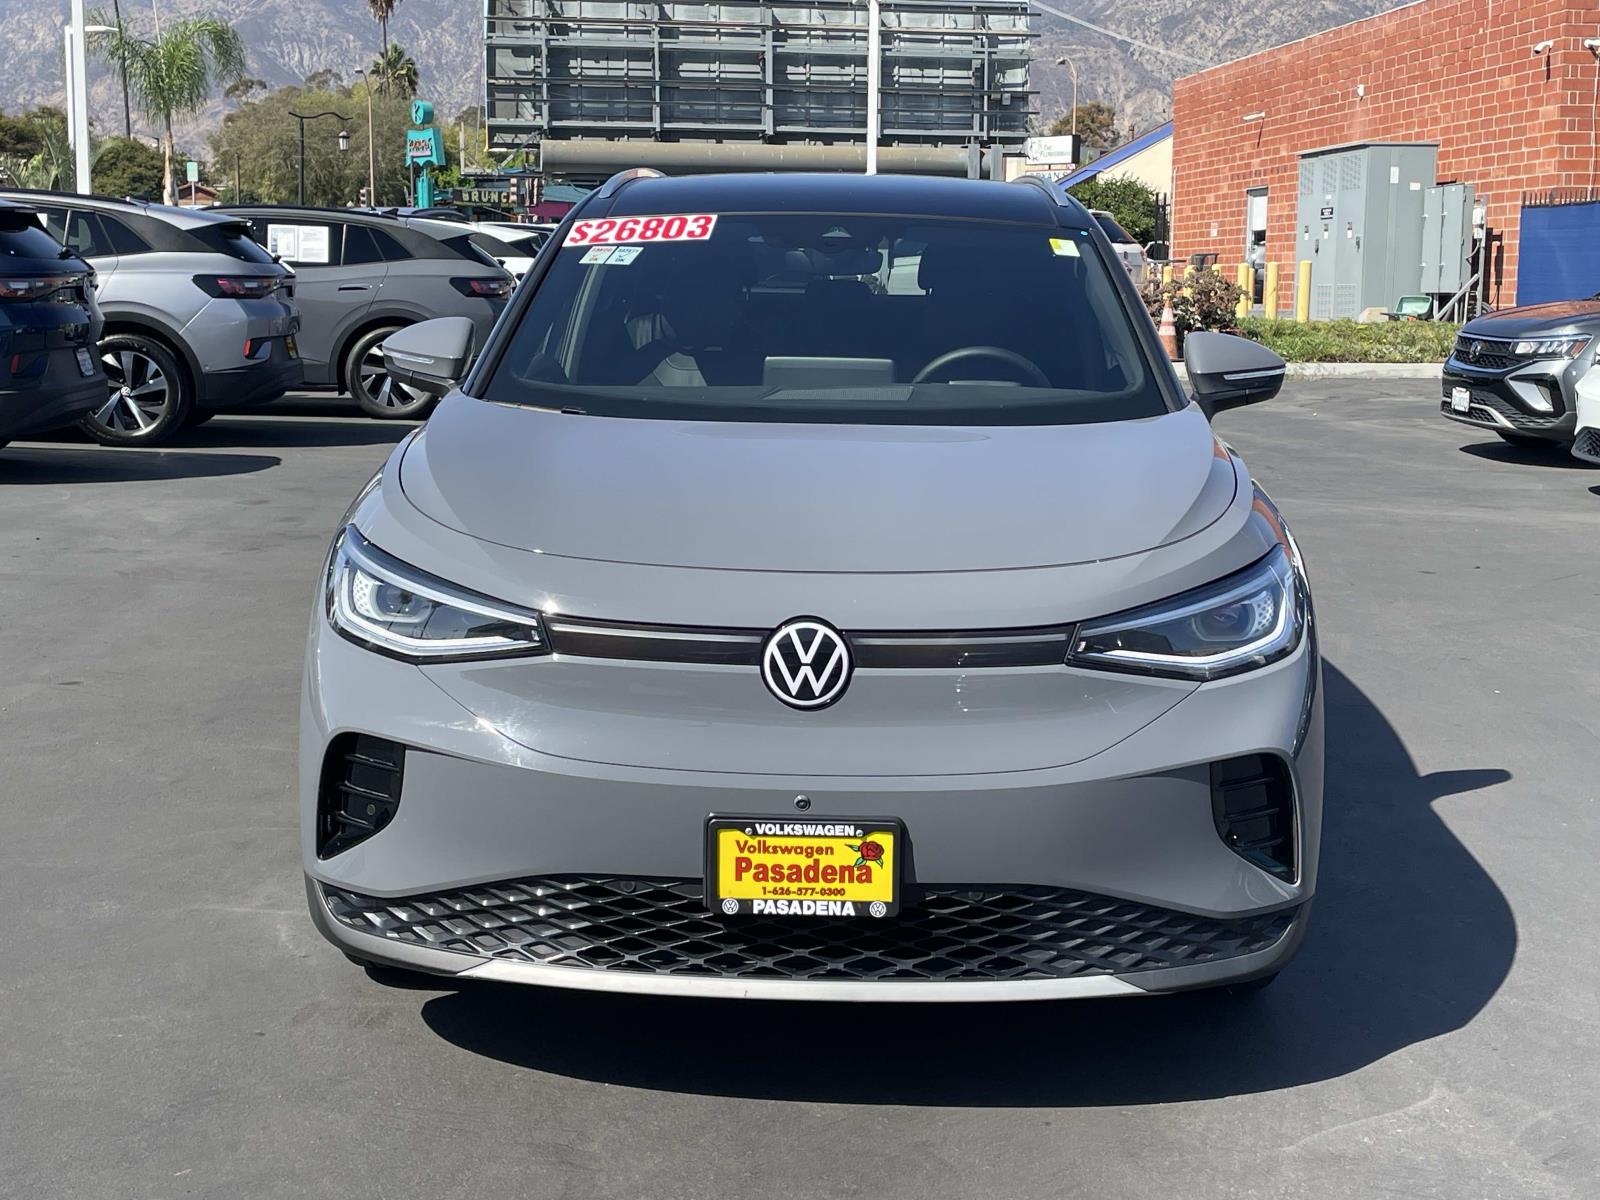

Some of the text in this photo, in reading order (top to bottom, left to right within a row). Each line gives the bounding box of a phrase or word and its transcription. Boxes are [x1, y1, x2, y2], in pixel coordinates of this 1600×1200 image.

[462, 190, 511, 203] BRUNC
[569, 215, 713, 244] $26803
[755, 823, 855, 837] VOLKSWAGEN
[735, 840, 834, 858] Volkswagen
[735, 857, 873, 884] Pasadena
[762, 886, 846, 897] 1-626-577-0300
[753, 899, 856, 917] PASADENA
